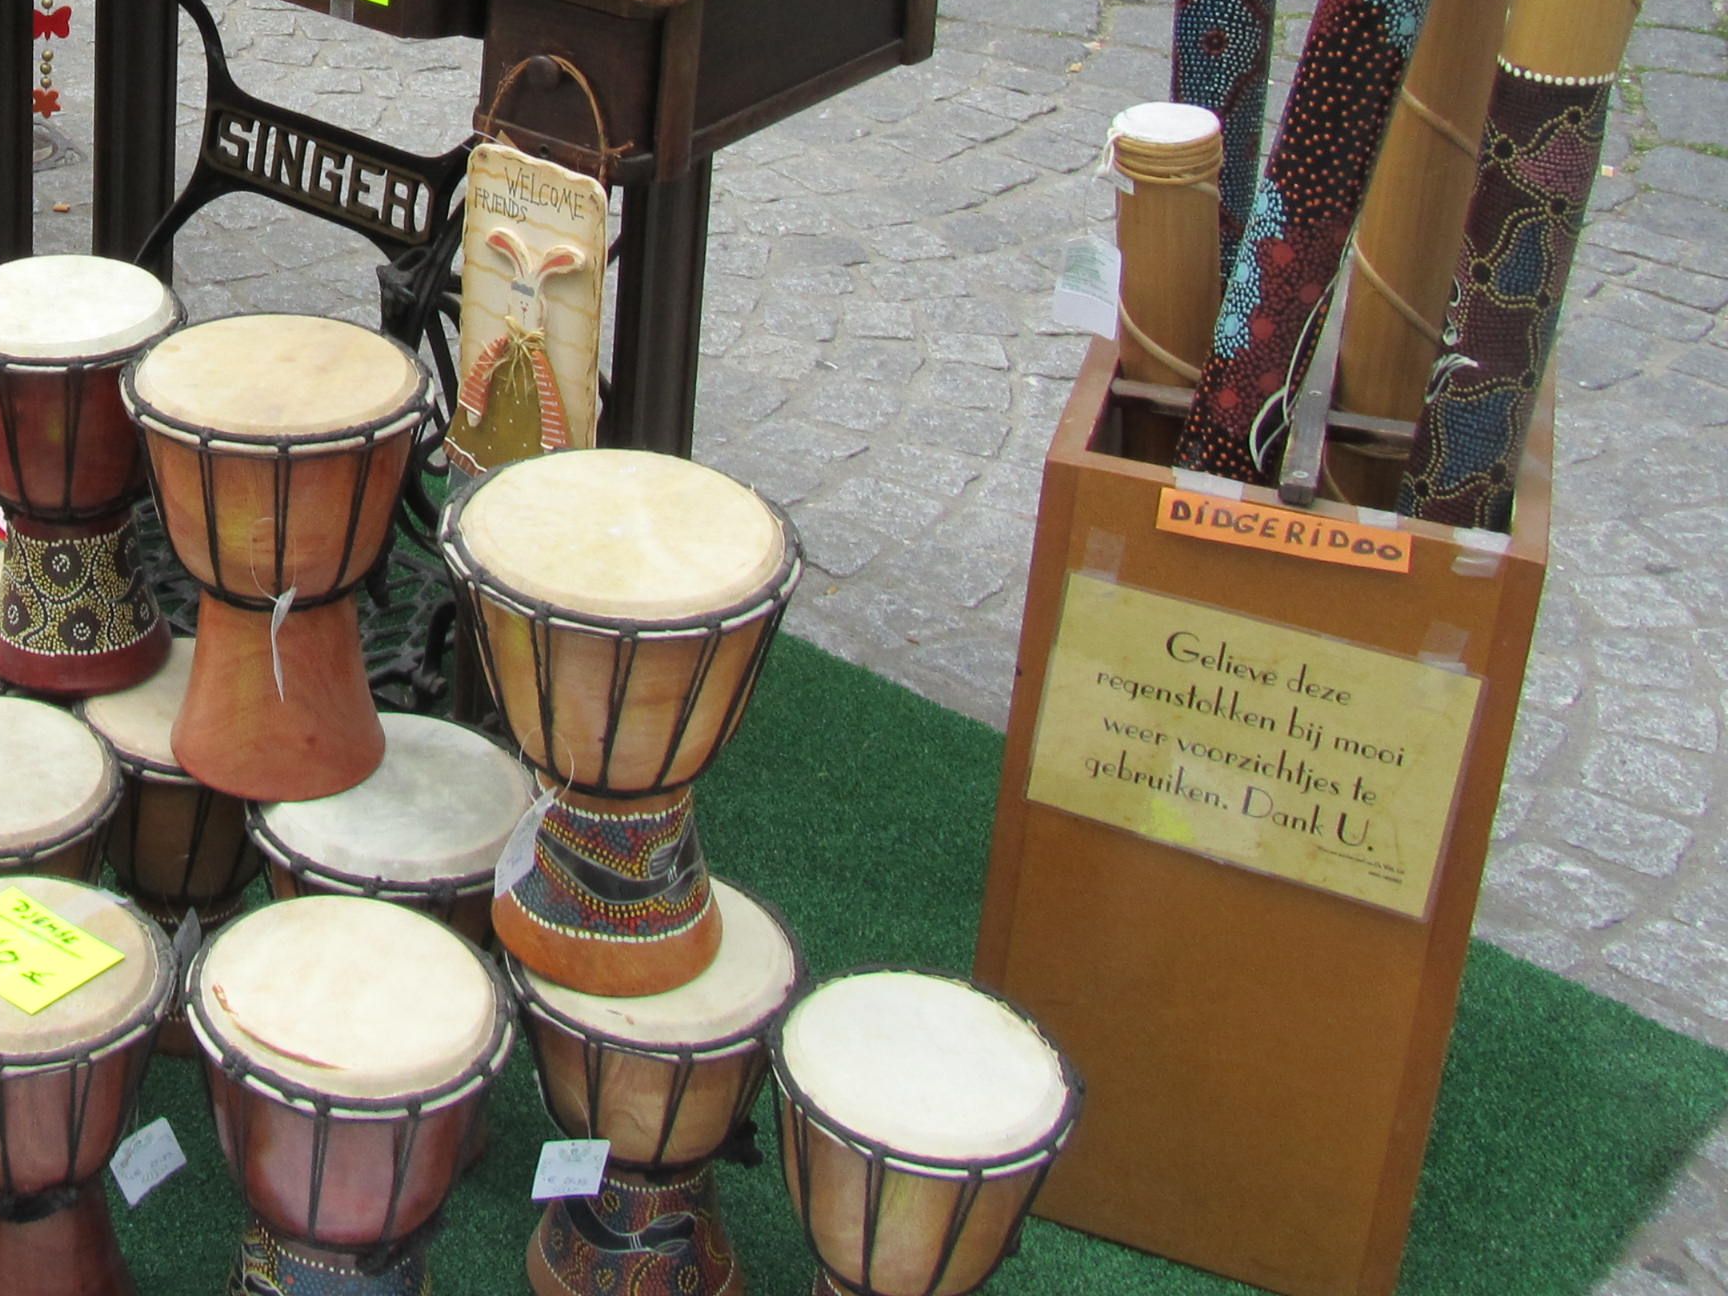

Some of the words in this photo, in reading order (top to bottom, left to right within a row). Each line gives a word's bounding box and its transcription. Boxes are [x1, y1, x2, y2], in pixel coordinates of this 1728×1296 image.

[217, 112, 424, 238] SINGER
[474, 186, 528, 225] FRIENDS
[503, 166, 586, 222] WELCOME
[1165, 630, 1279, 687] Gelieve
[1285, 663, 1353, 706] deze
[1095, 670, 1277, 733] regenstokken
[1287, 705, 1324, 751] bij
[1332, 734, 1407, 768] mooi
[1102, 716, 1169, 747] weer
[1176, 737, 1342, 795] voorzichtjes
[1351, 775, 1378, 807] te
[1083, 749, 1229, 811] gebruiken.
[1240, 784, 1325, 838] Dank
[1335, 810, 1375, 853] U.
